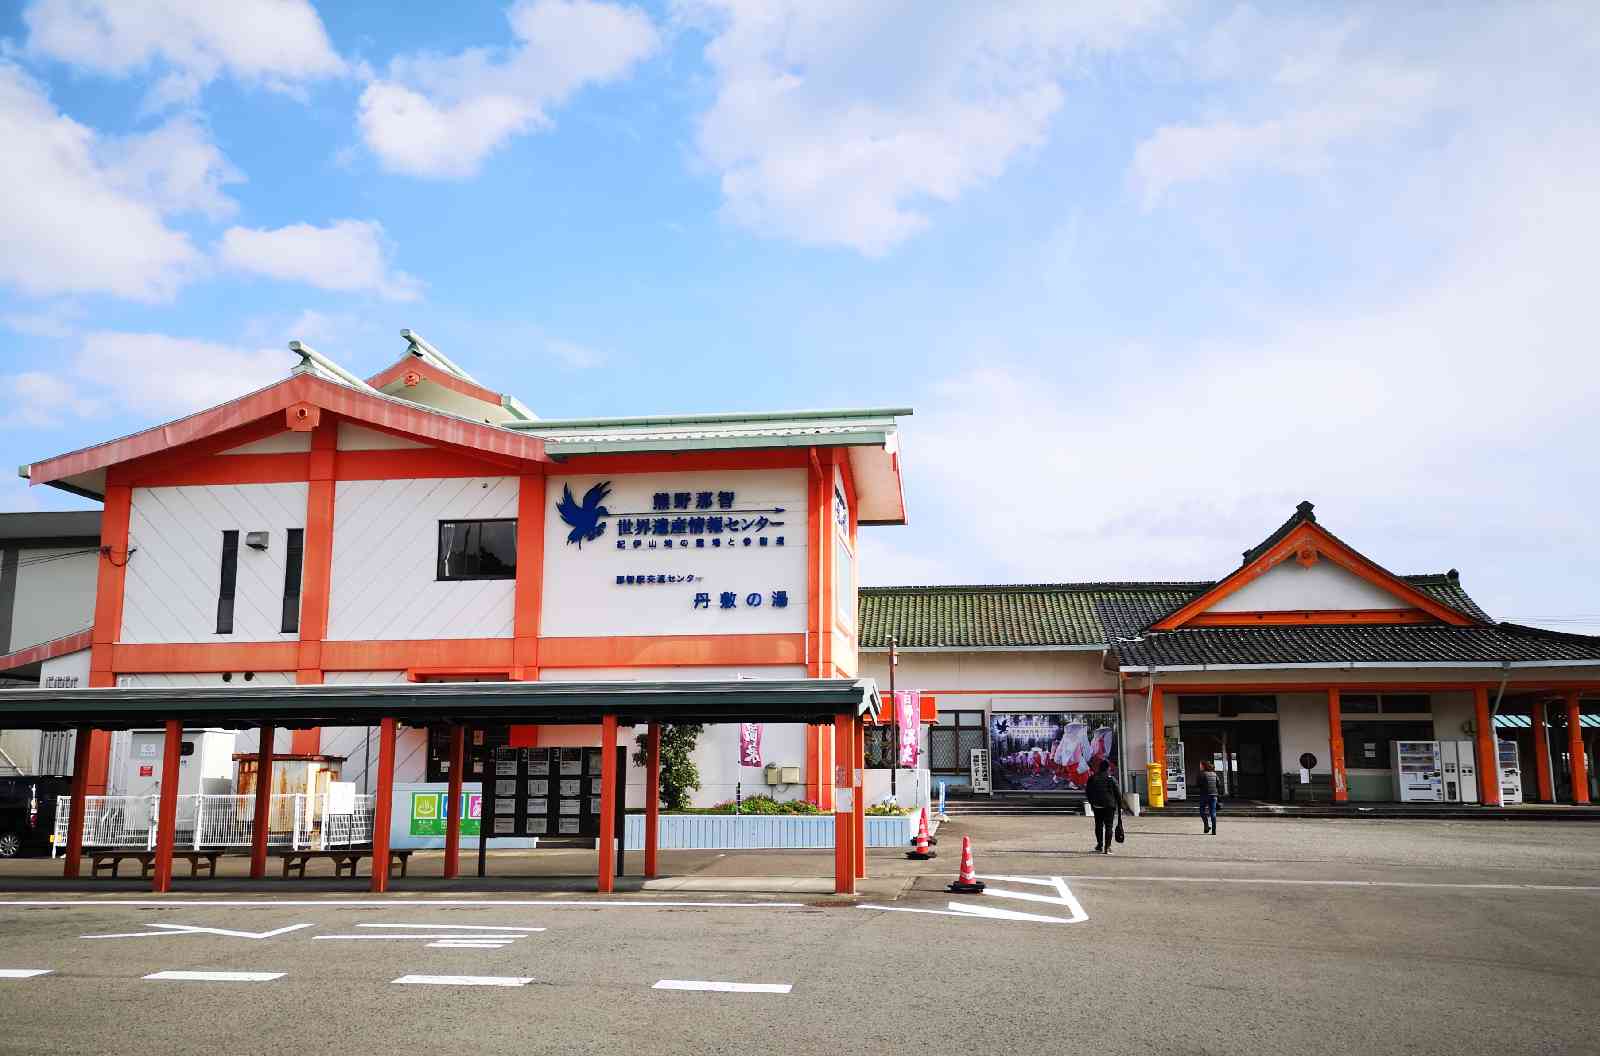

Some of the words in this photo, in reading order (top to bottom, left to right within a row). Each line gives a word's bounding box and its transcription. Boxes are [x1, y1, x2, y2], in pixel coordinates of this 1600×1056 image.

[653, 491, 735, 510] 熊野那智
[617, 515, 784, 536] 世界遺産情報センター
[694, 591, 788, 609] 丹敷の湯
